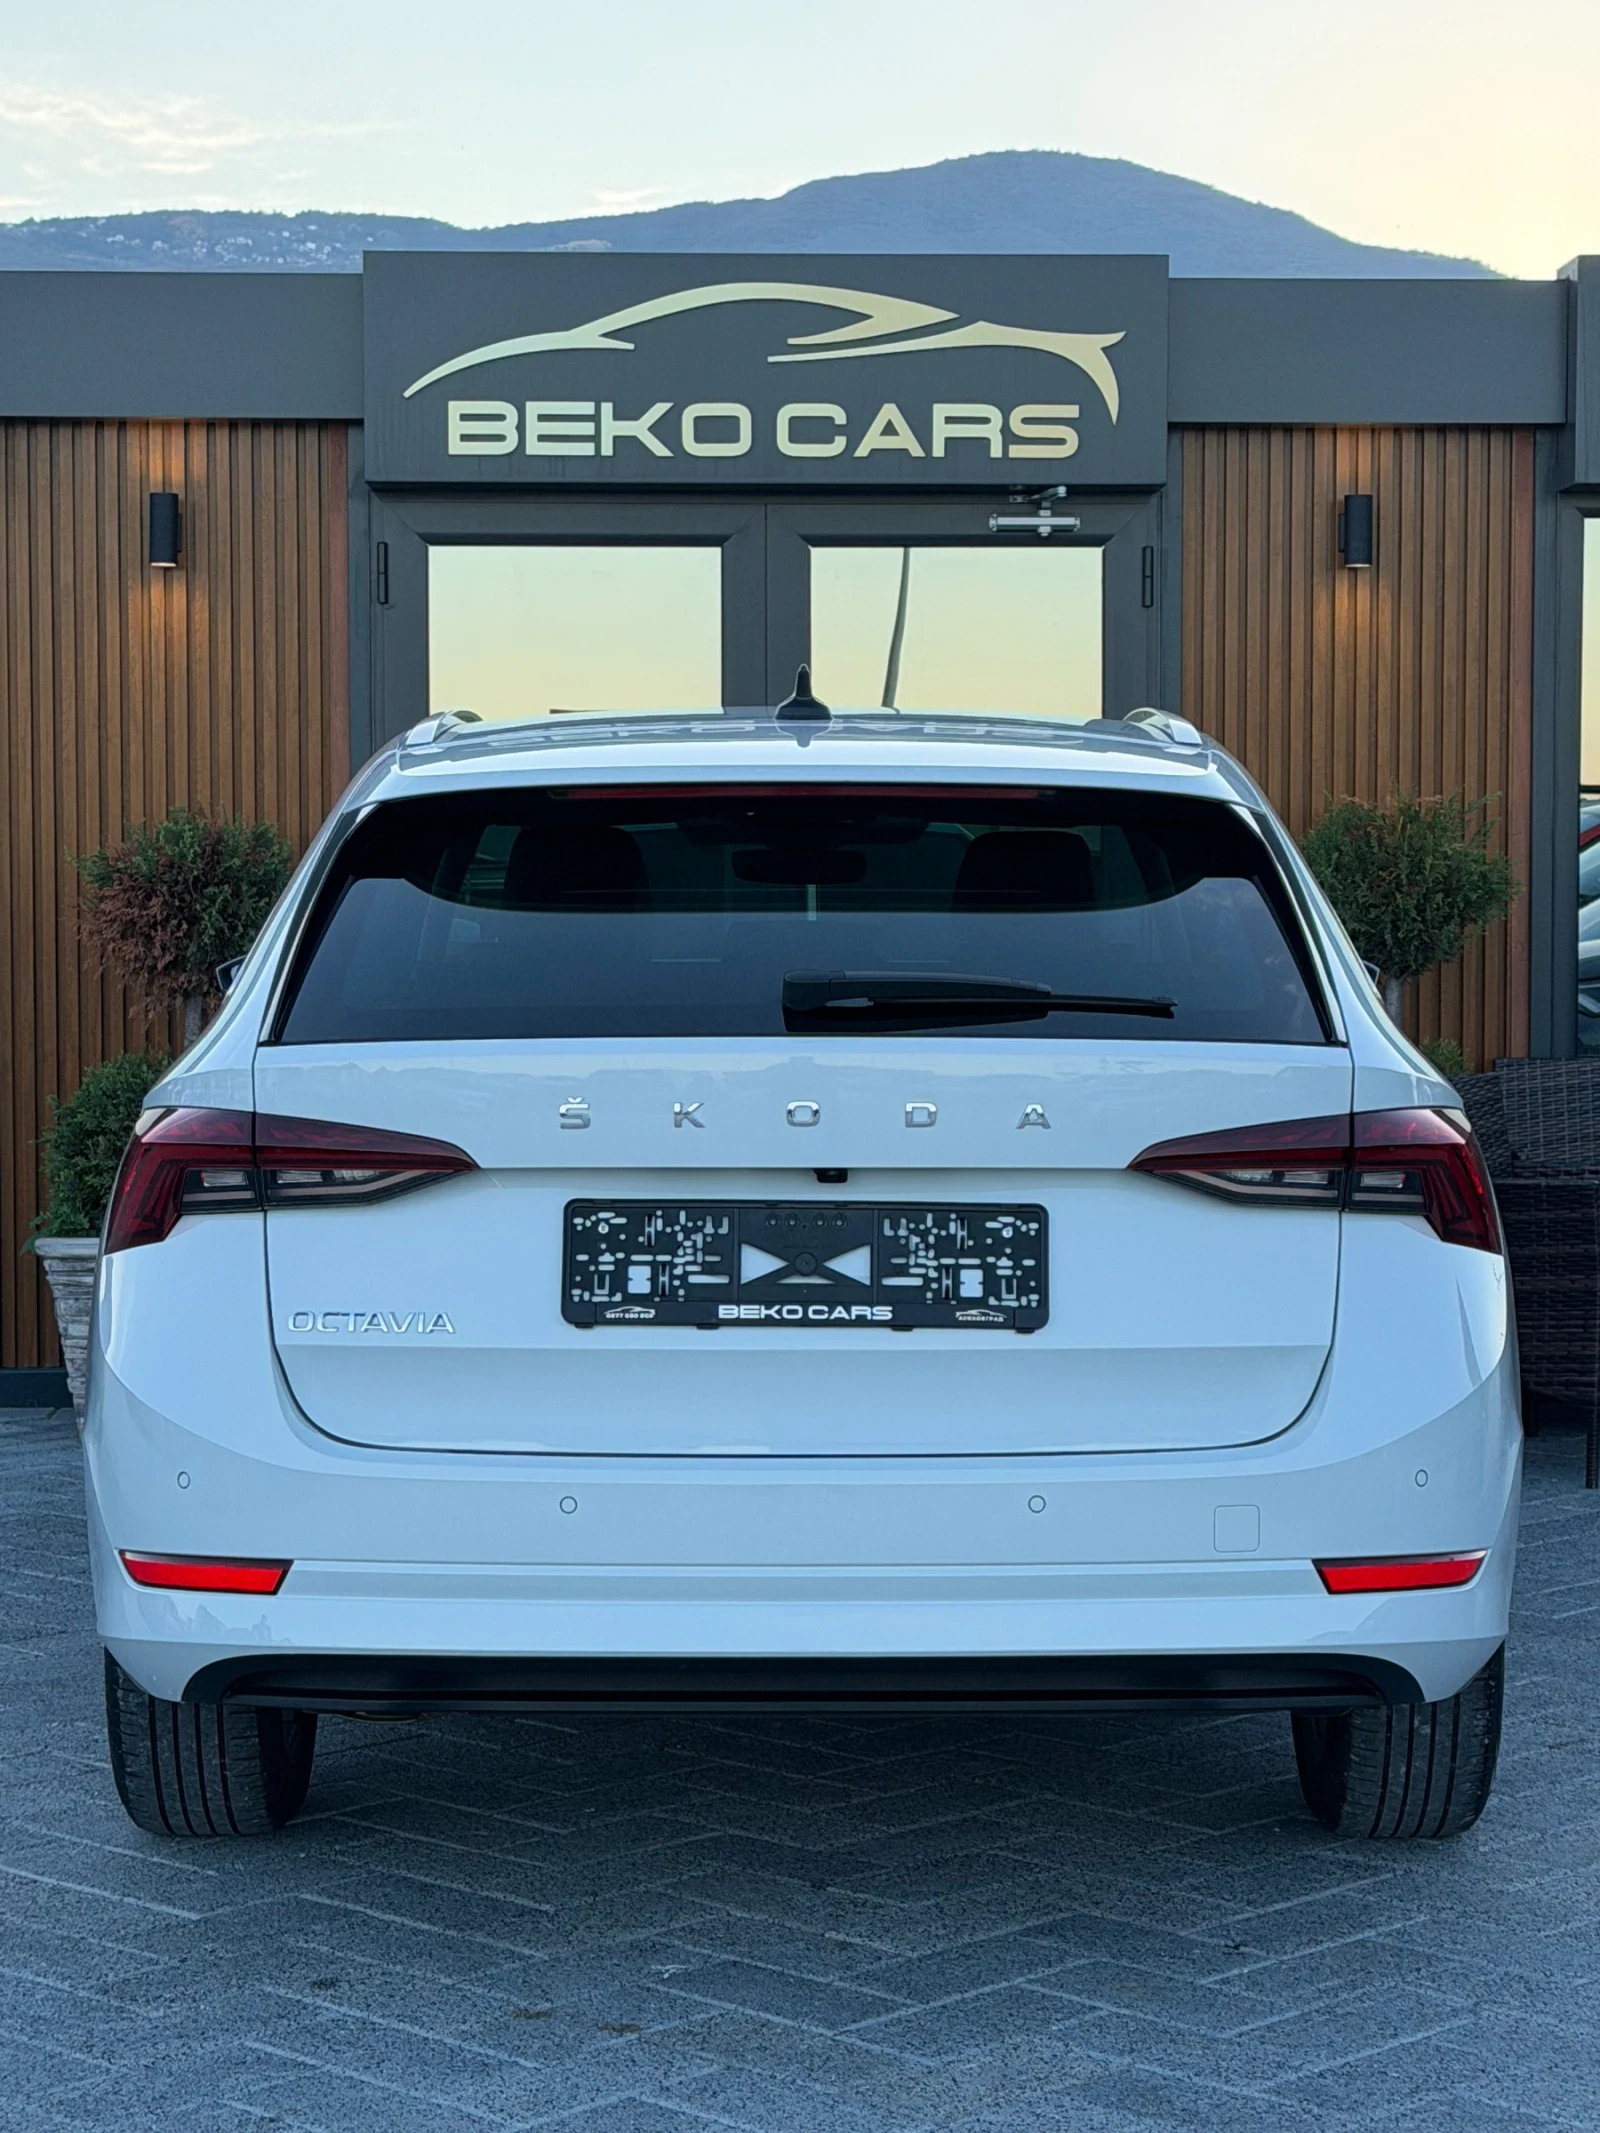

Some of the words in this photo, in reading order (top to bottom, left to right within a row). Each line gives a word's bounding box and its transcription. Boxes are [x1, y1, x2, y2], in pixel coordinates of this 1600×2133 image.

[447, 400, 754, 458] BEKO
[775, 402, 1081, 460] CARS
[558, 1096, 1052, 1130] ŠKODA
[287, 1310, 456, 1334] OCTAVIA
[717, 1304, 804, 1320] BEKO
[807, 1305, 893, 1321] CARS
